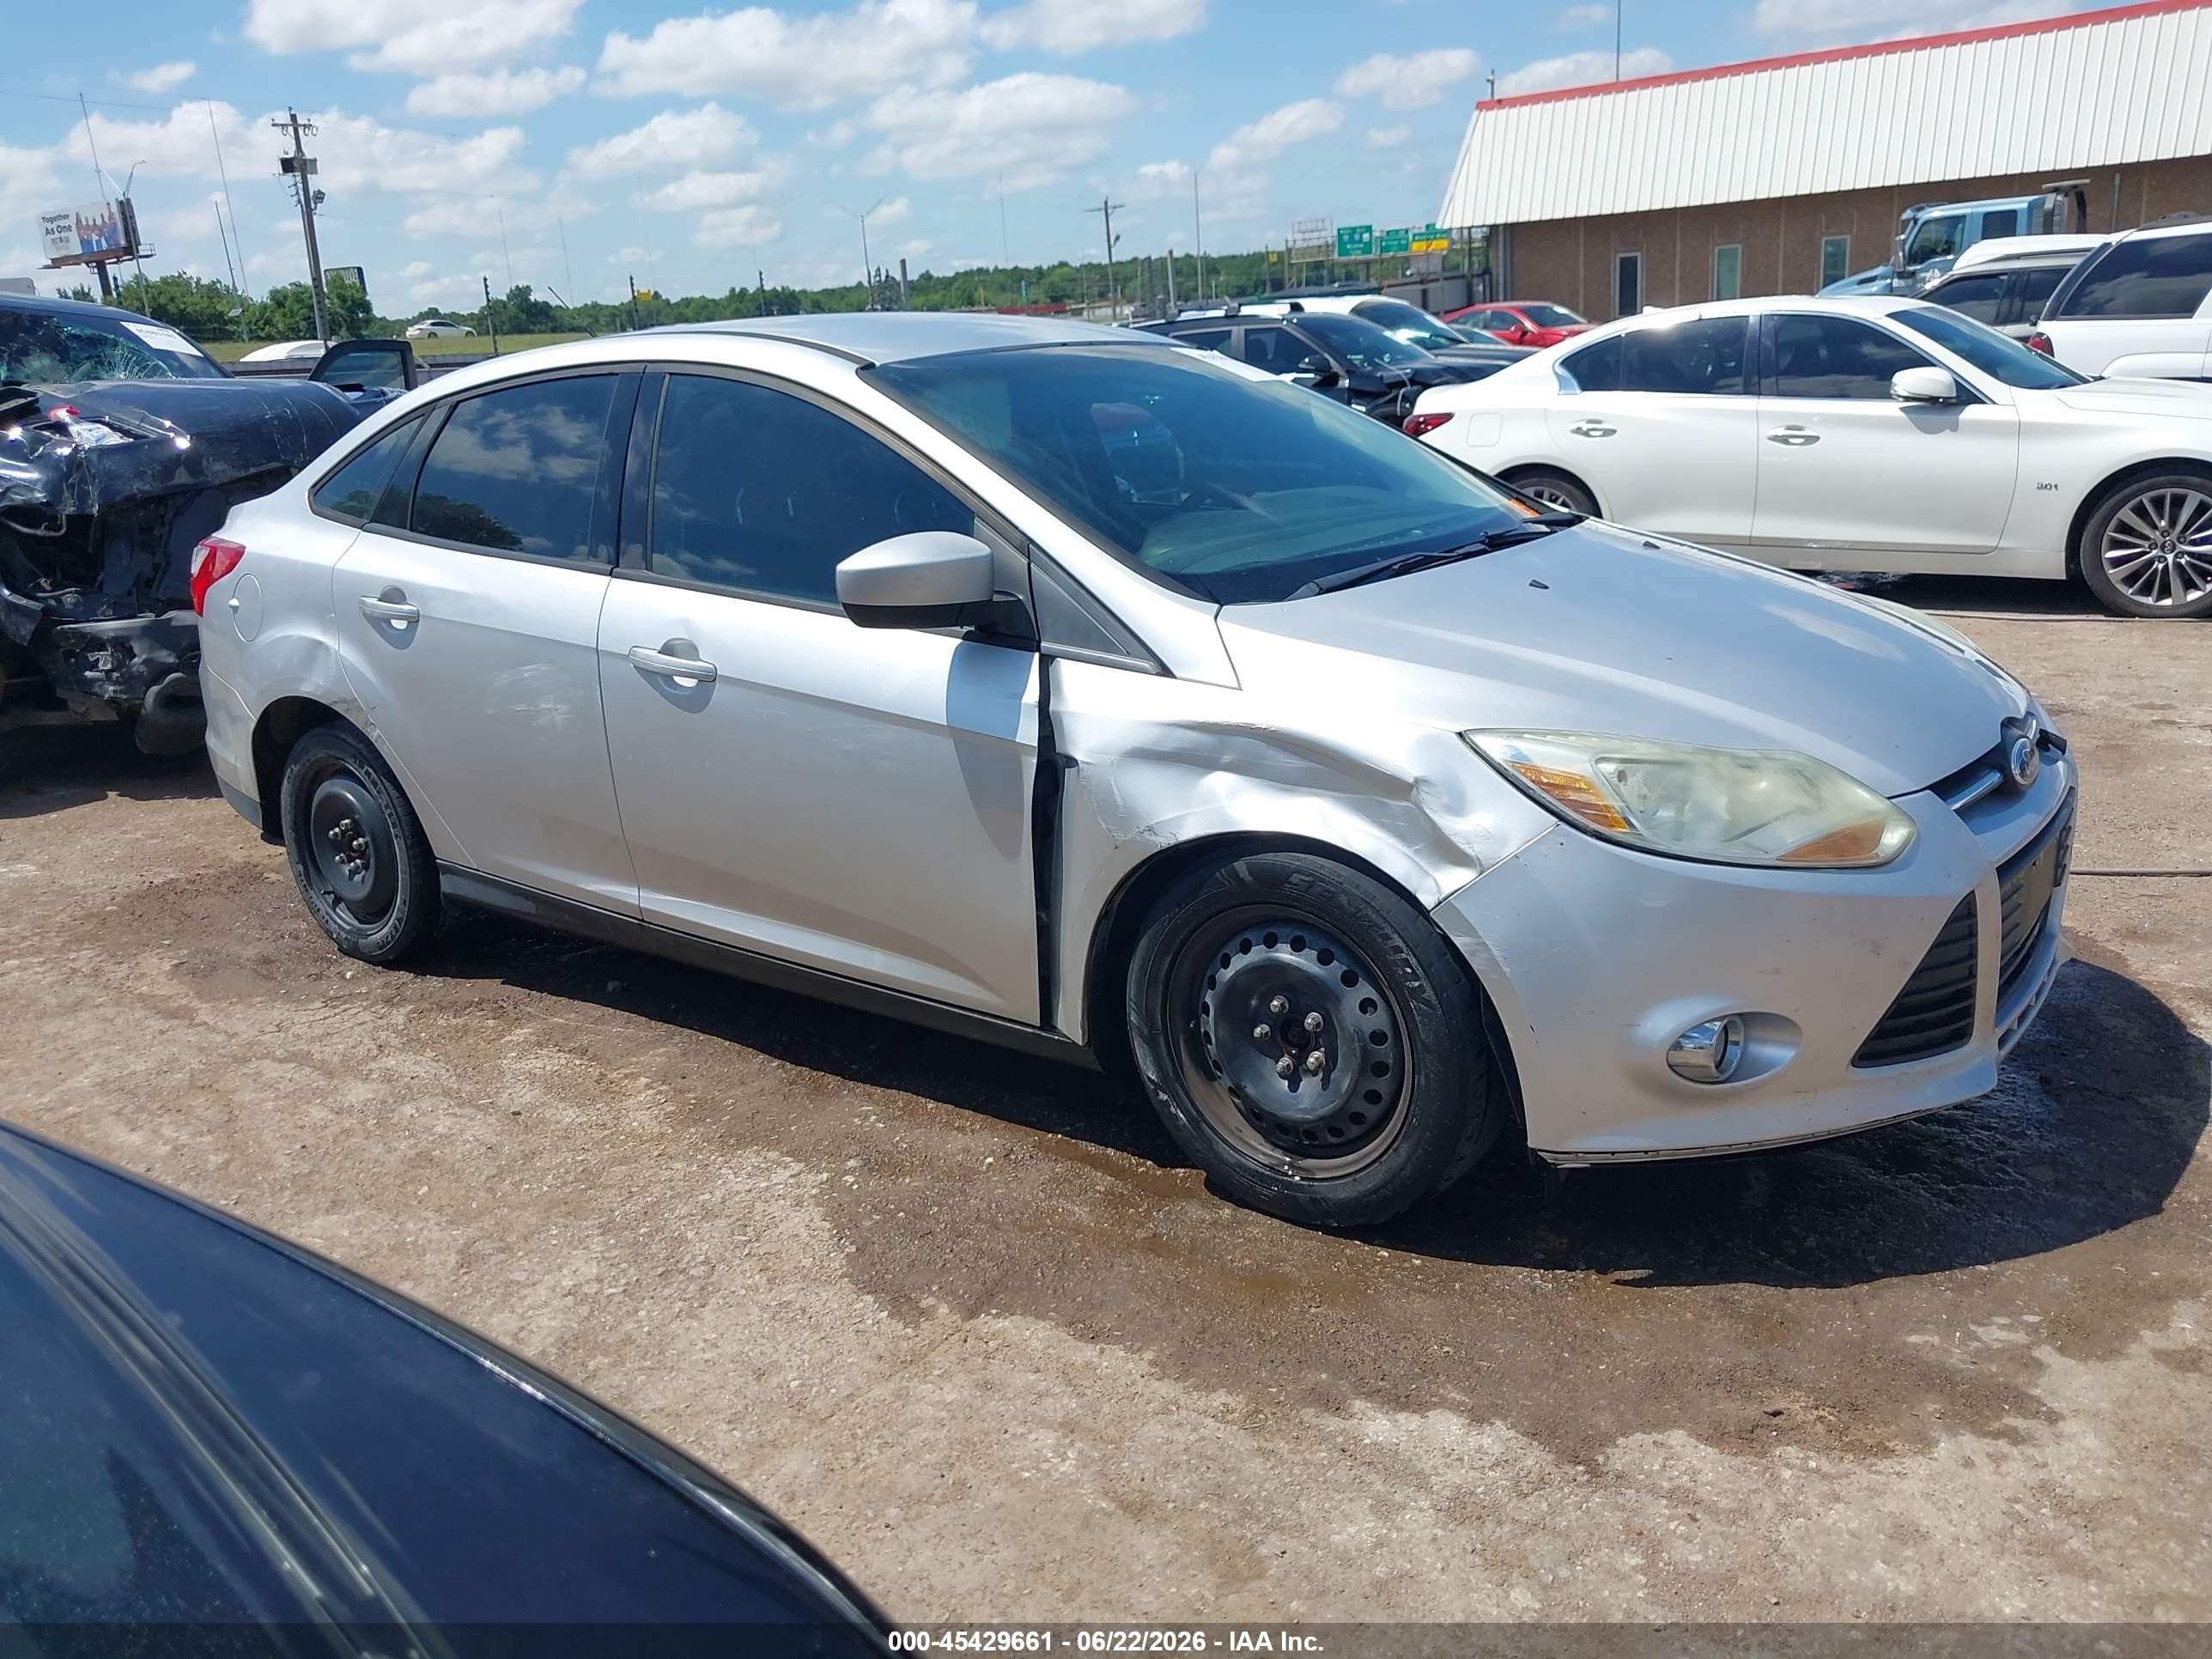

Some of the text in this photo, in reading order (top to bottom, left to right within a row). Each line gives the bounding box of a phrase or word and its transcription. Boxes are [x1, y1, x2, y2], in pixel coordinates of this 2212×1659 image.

[41, 213, 70, 224] Together
[46, 224, 72, 236] As One
